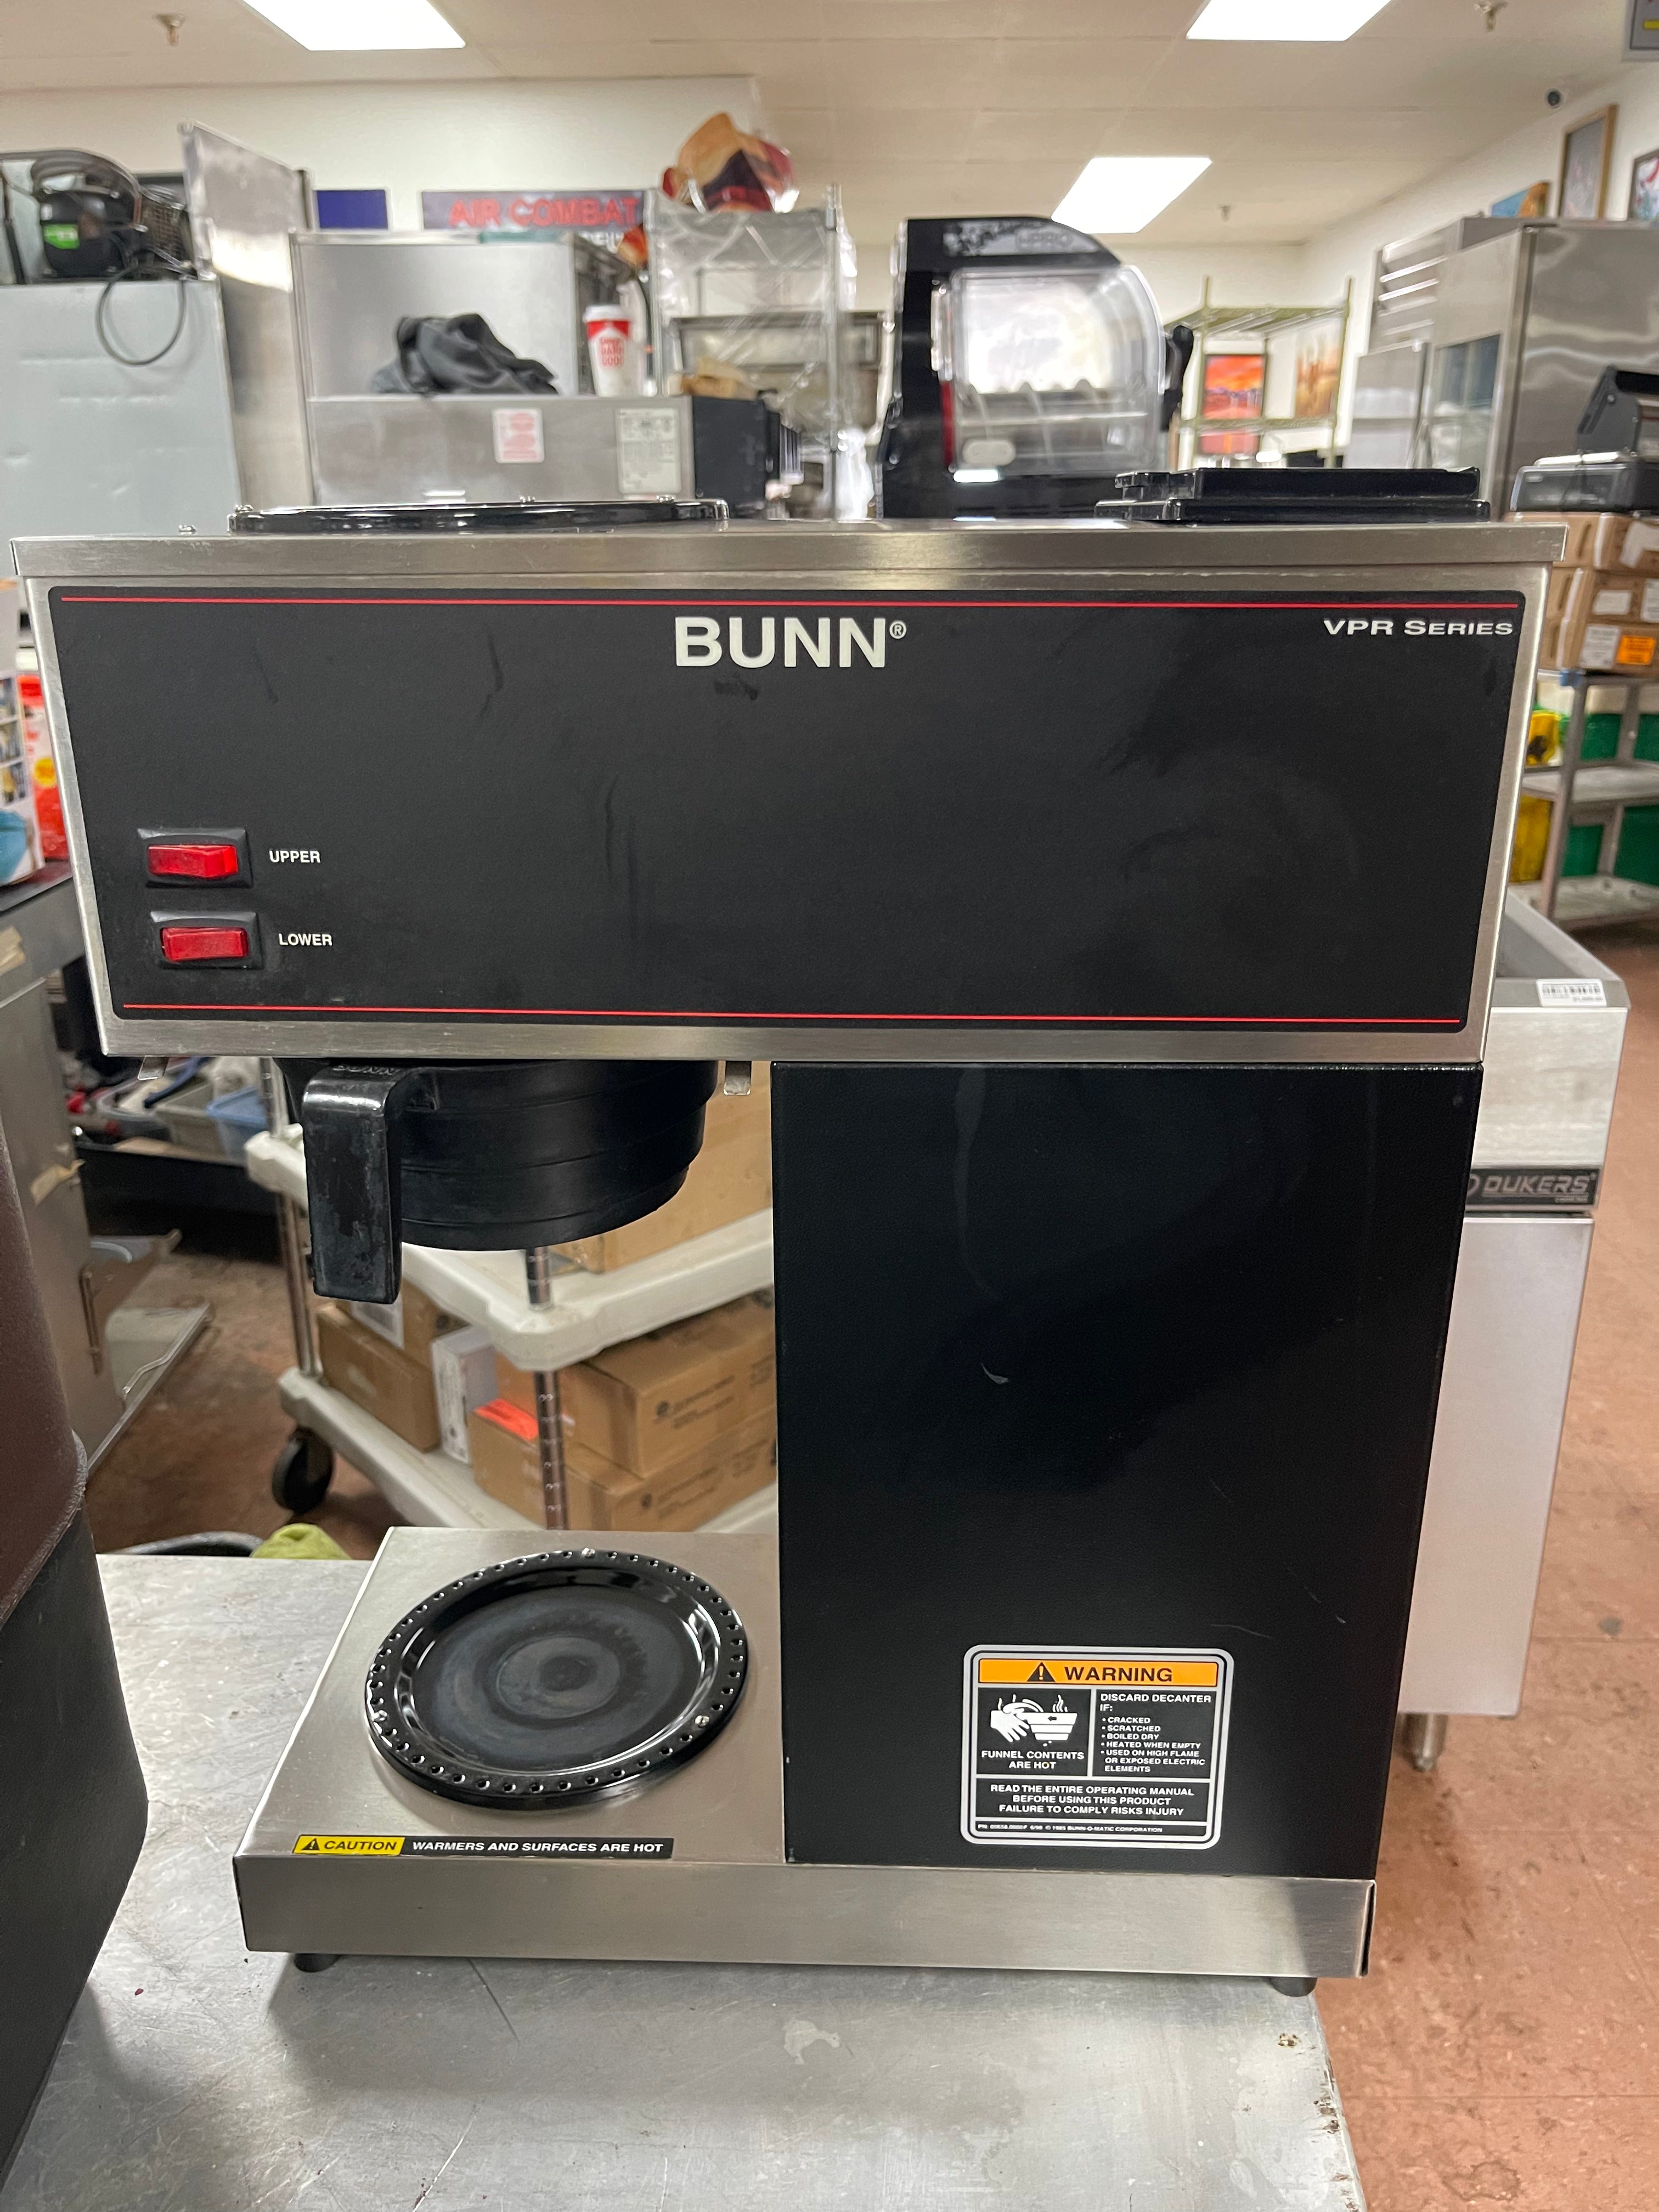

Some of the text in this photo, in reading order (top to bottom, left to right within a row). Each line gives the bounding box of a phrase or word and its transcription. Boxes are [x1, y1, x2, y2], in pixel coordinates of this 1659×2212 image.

[448, 197, 639, 228] AIR COMBAT
[1323, 620, 1513, 635] VPR SERIES
[269, 850, 321, 863] UPPER
[279, 933, 332, 946] LOWER
[1483, 1175, 1590, 1194] DUKERS
[1064, 1667, 1172, 1681] WARNING
[1152, 1694, 1211, 1702] DECANTER
[981, 1750, 1085, 1759] FUNNEL CONTENTS
[990, 1784, 1020, 1792] READ
[1045, 1786, 1083, 1794] ENTIRE
[1086, 1786, 1147, 1795] OPERATING
[1150, 1787, 1194, 1796] MANUAL
[1058, 1796, 1091, 1804] USING
[1093, 1796, 1117, 1804] THIS
[1120, 1797, 1171, 1805] PRODUCT
[999, 1804, 1044, 1813] FAILURE
[1064, 1805, 1108, 1814] COMPLY
[1111, 1807, 1143, 1815] RISKS
[1146, 1807, 1184, 1816] INJURY
[324, 1841, 663, 1853] CAUTION WARMERS AND SURFACES ARE HOT
